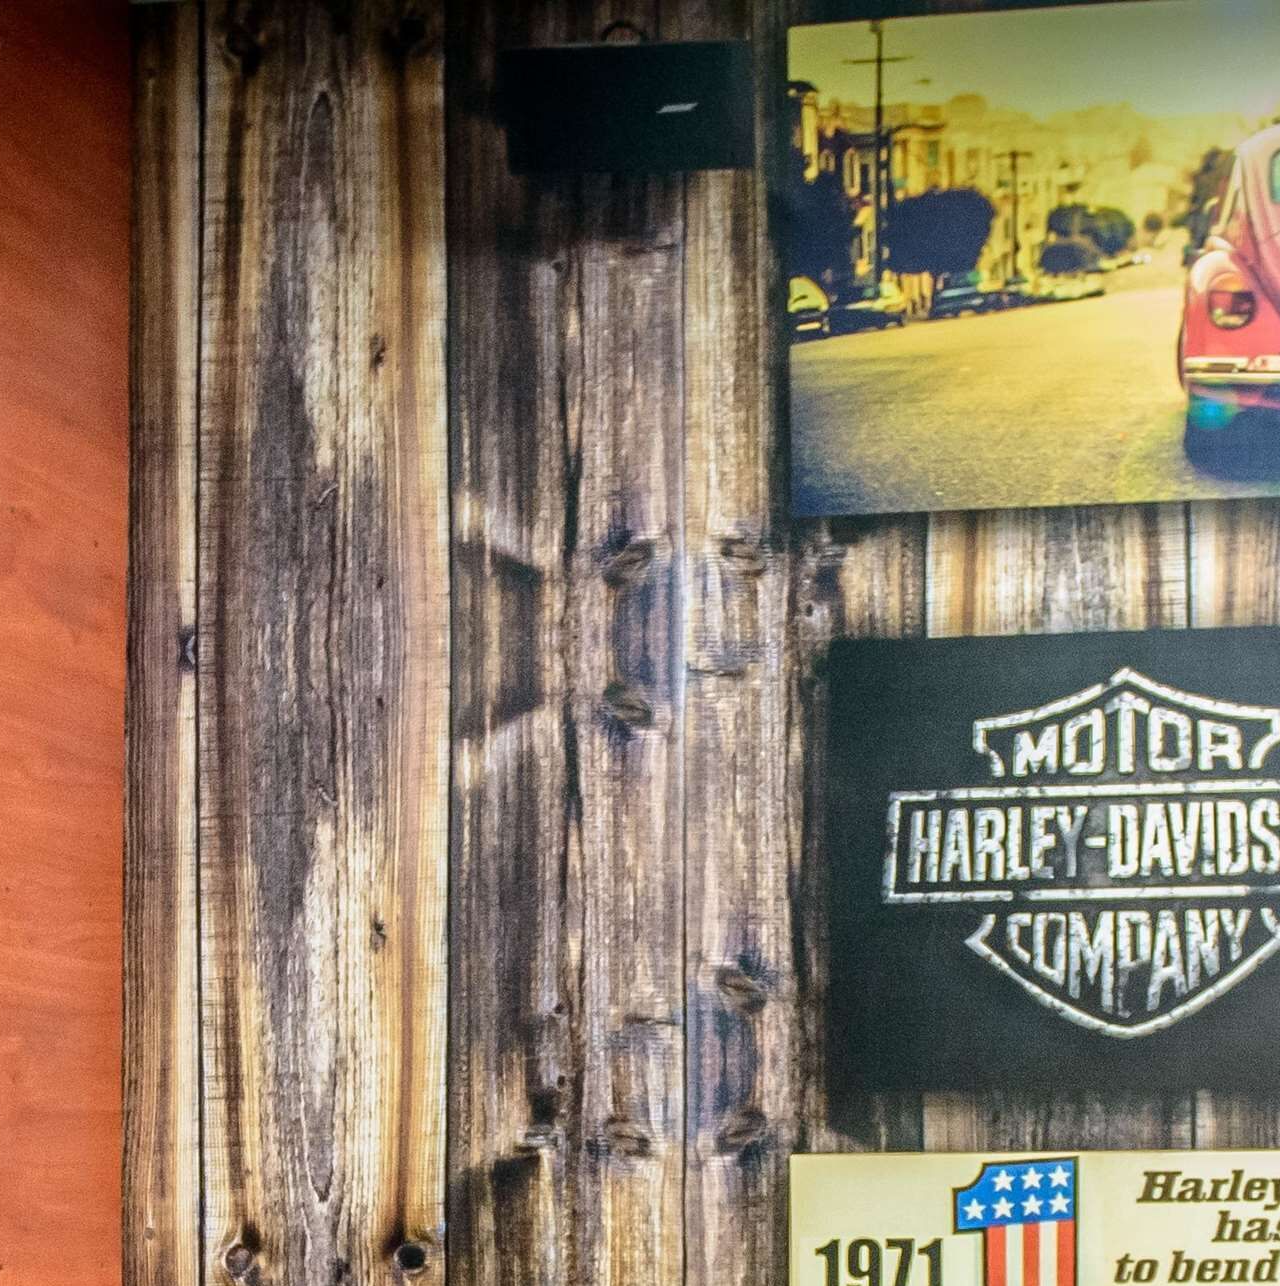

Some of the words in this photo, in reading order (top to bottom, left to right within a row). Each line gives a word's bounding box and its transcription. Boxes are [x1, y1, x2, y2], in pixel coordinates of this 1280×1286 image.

[1012, 690, 1244, 776] MOTOR
[1006, 908, 1252, 1018] COMPANY
[1113, 1252, 1159, 1285] to
